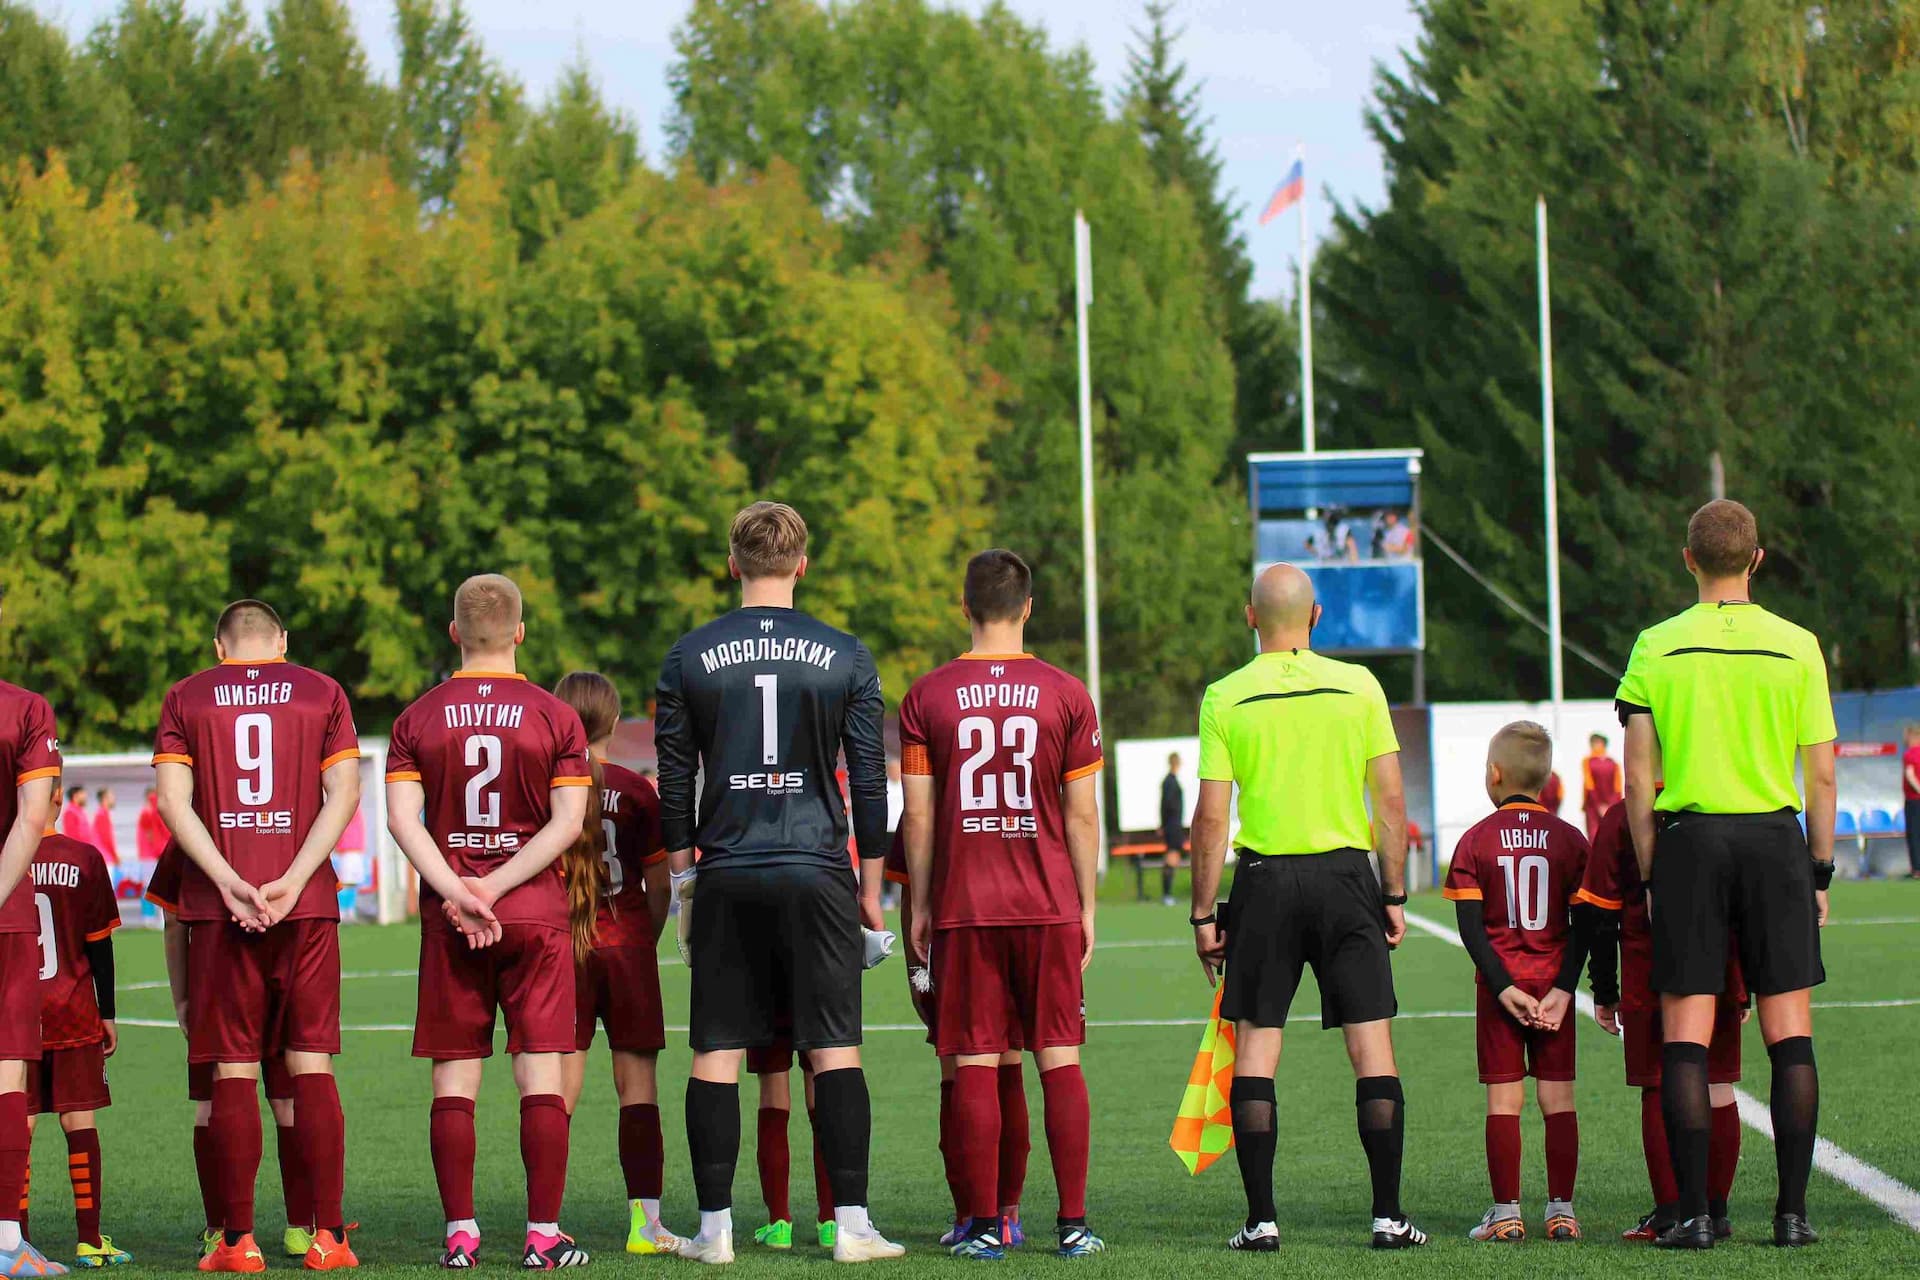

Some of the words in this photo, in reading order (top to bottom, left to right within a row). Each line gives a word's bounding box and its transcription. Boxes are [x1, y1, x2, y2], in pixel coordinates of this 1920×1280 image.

[700, 637, 837, 674] МАСАЛЬСКИХ
[214, 682, 292, 706] ШИБАЕВ
[956, 683, 1040, 710] ВОРОНА
[444, 703, 524, 729] ПЛУГИН
[754, 674, 778, 766] 1
[234, 712, 273, 806] 9
[957, 715, 1039, 811] 23
[464, 734, 502, 827] 2
[729, 771, 804, 790] SEUS
[785, 787, 804, 795] Union
[219, 811, 292, 829] SEUS
[962, 815, 1038, 833] SEUS
[447, 832, 519, 849] SEUS
[1499, 828, 1550, 852] ЦВЫК
[1496, 855, 1550, 931] 10
